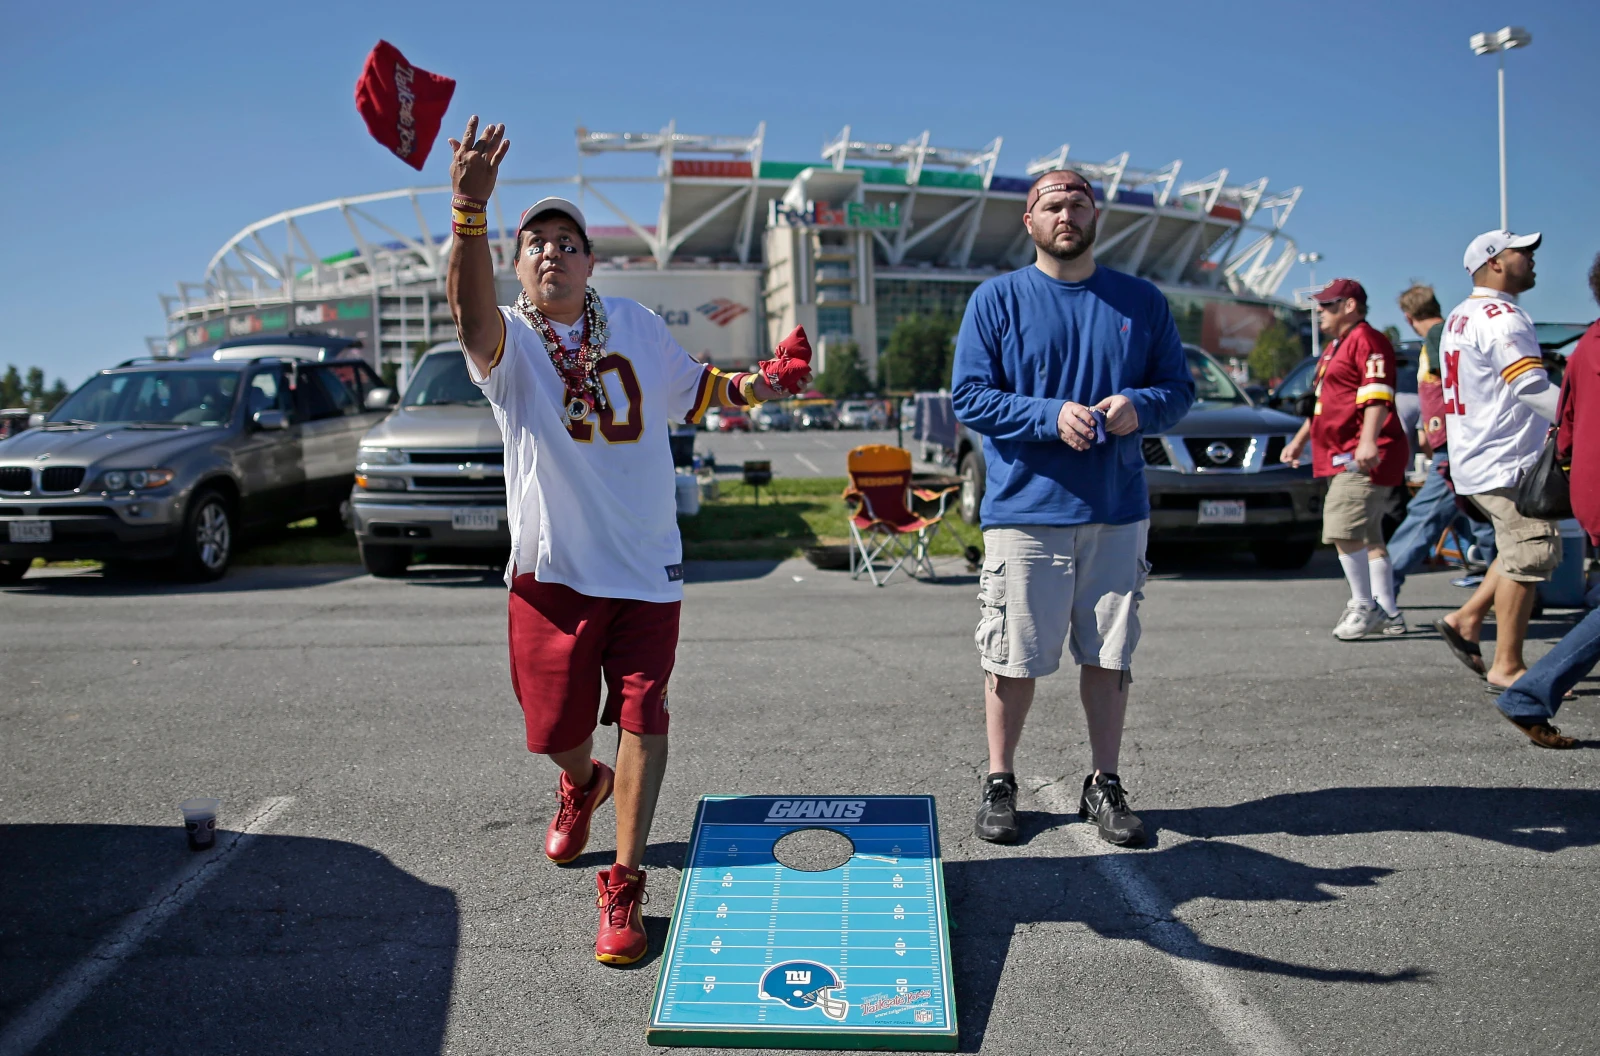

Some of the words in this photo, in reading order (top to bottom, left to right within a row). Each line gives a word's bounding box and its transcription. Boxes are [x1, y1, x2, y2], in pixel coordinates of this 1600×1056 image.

[1482, 302, 1517, 319] 21
[1365, 359, 1386, 379] 11
[767, 800, 867, 819] GIANTS
[721, 876, 734, 888] 20
[892, 876, 904, 889] 20
[716, 906, 728, 919] 30
[893, 907, 905, 920] 30
[709, 940, 722, 955] 40
[894, 942, 906, 957] 40
[703, 975, 716, 990] 50
[895, 978, 908, 994] 50
